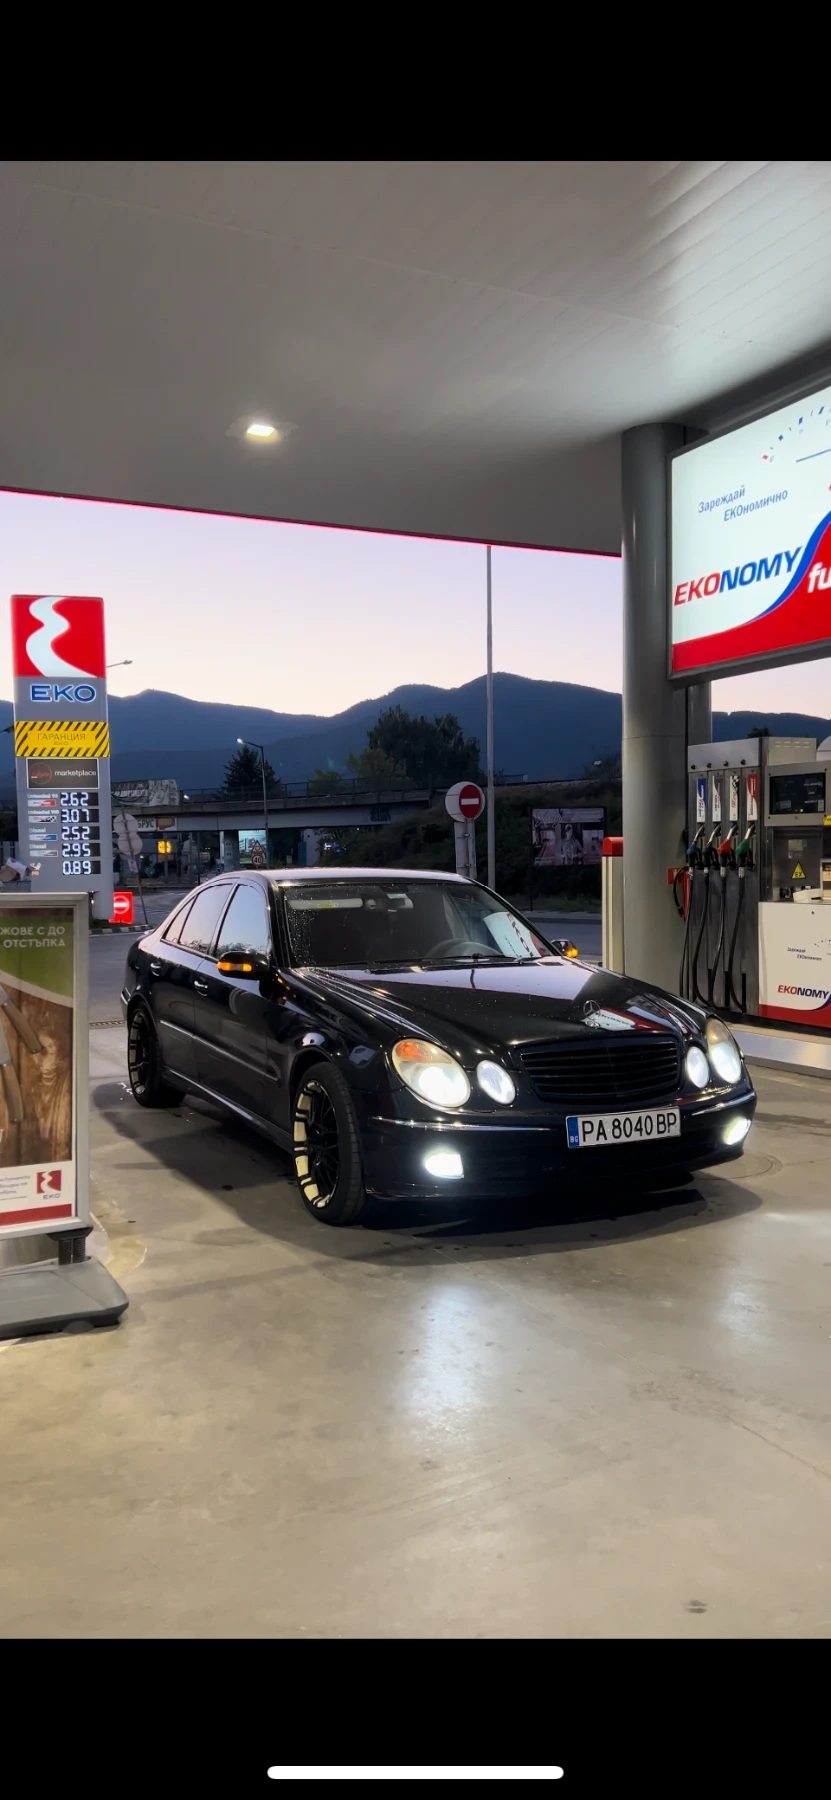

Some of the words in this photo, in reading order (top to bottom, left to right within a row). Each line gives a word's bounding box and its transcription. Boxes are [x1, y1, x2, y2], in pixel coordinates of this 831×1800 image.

[698, 485, 745, 513] Зареждай
[723, 490, 788, 521] ЕКОномично
[674, 546, 803, 606] EKONOMY
[30, 684, 96, 703] EKO
[37, 733, 86, 742] ГАРАНЦИЯ
[54, 769, 96, 777] marketplace
[60, 792, 89, 806] 2.62
[61, 809, 90, 823] 3.07
[61, 826, 90, 840] 2.52
[62, 843, 91, 857] 2.95
[254, 856, 262, 864] 40
[62, 860, 92, 875] 0.89
[0, 926, 34, 936] ЖОВЕ
[37, 926, 45, 935] С
[48, 926, 66, 936] ДО
[3, 938, 66, 948] ОТСТЪПКА
[777, 984, 829, 1000] EKONOMY
[581, 1120, 607, 1142] PA
[611, 1115, 653, 1140] 8040
[656, 1112, 677, 1135] BP
[569, 1135, 579, 1143] BG
